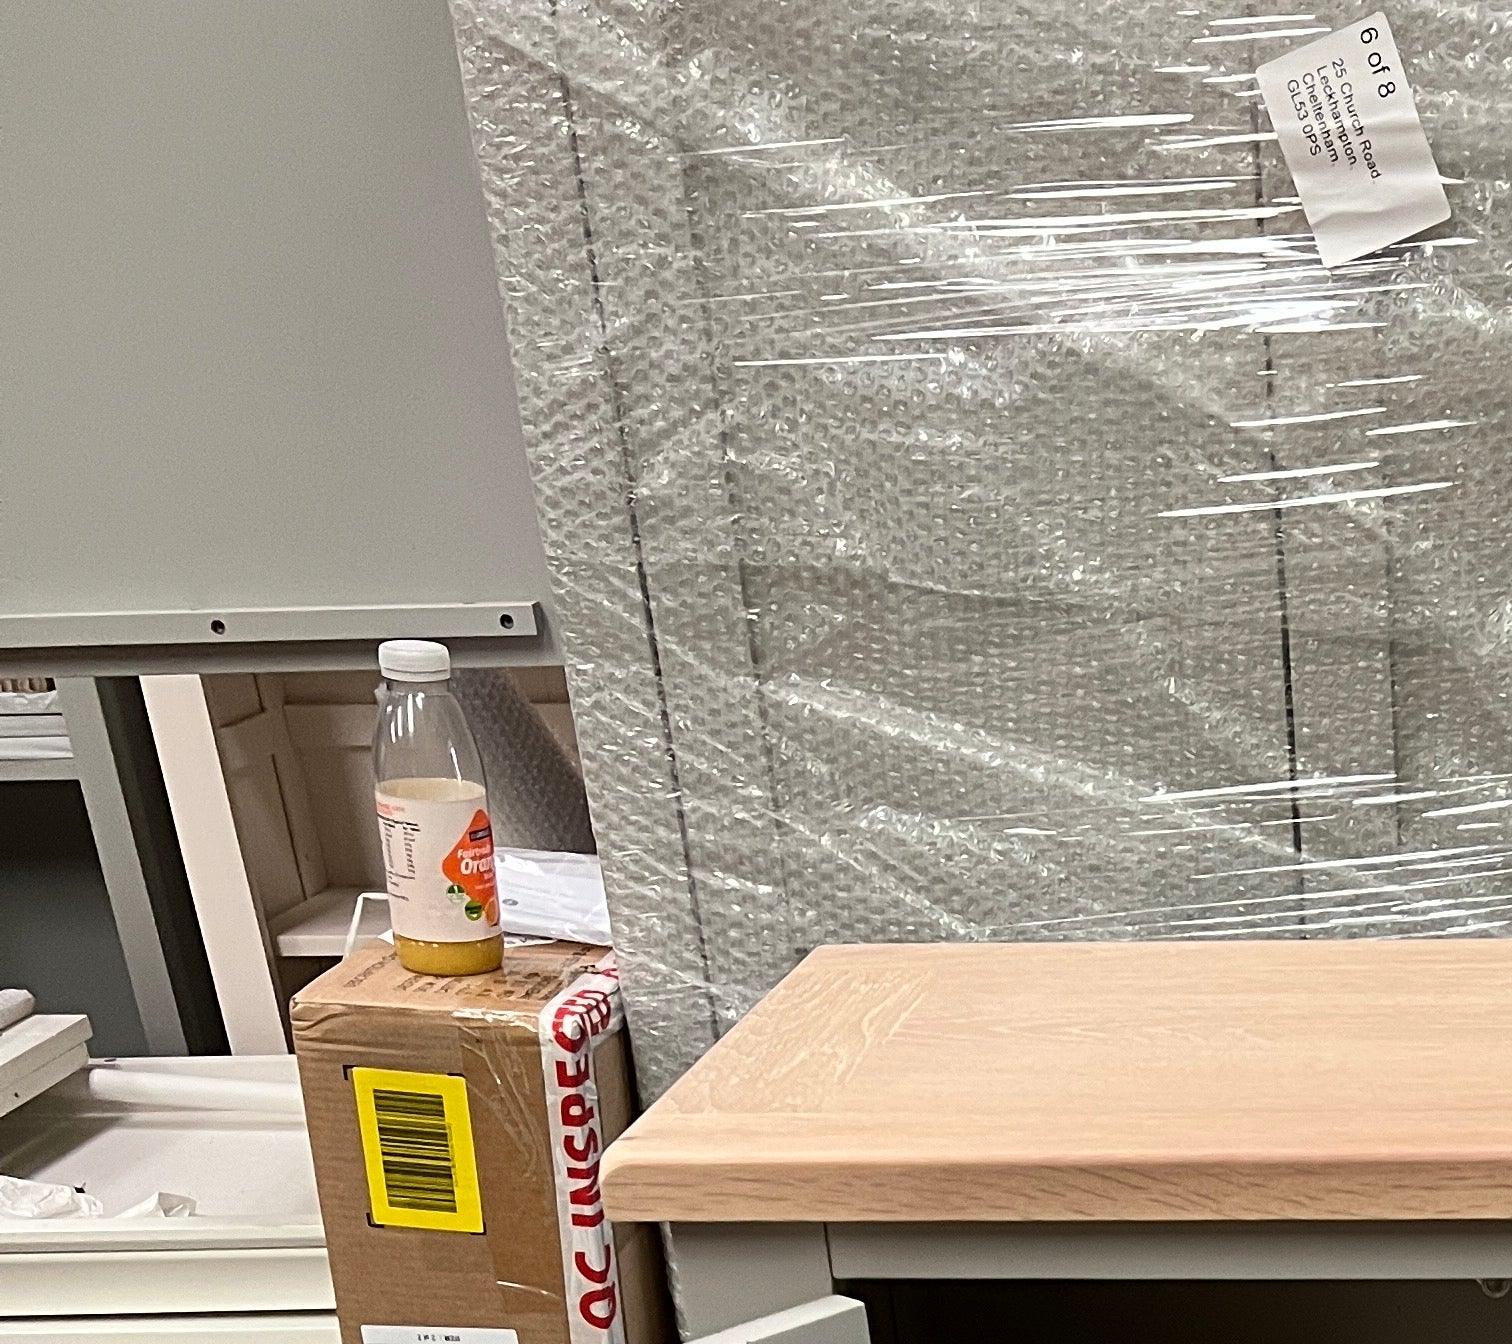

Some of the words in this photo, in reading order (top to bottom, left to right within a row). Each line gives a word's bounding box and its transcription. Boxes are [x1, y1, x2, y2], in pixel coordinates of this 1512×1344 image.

[1360, 27, 1379, 44] 6
[1367, 52, 1390, 75] of
[1287, 79, 1309, 121] GL53
[1332, 57, 1347, 79] 25
[1340, 82, 1364, 137] Church
[1377, 81, 1396, 98] 8
[574, 1243, 617, 1330] QC
